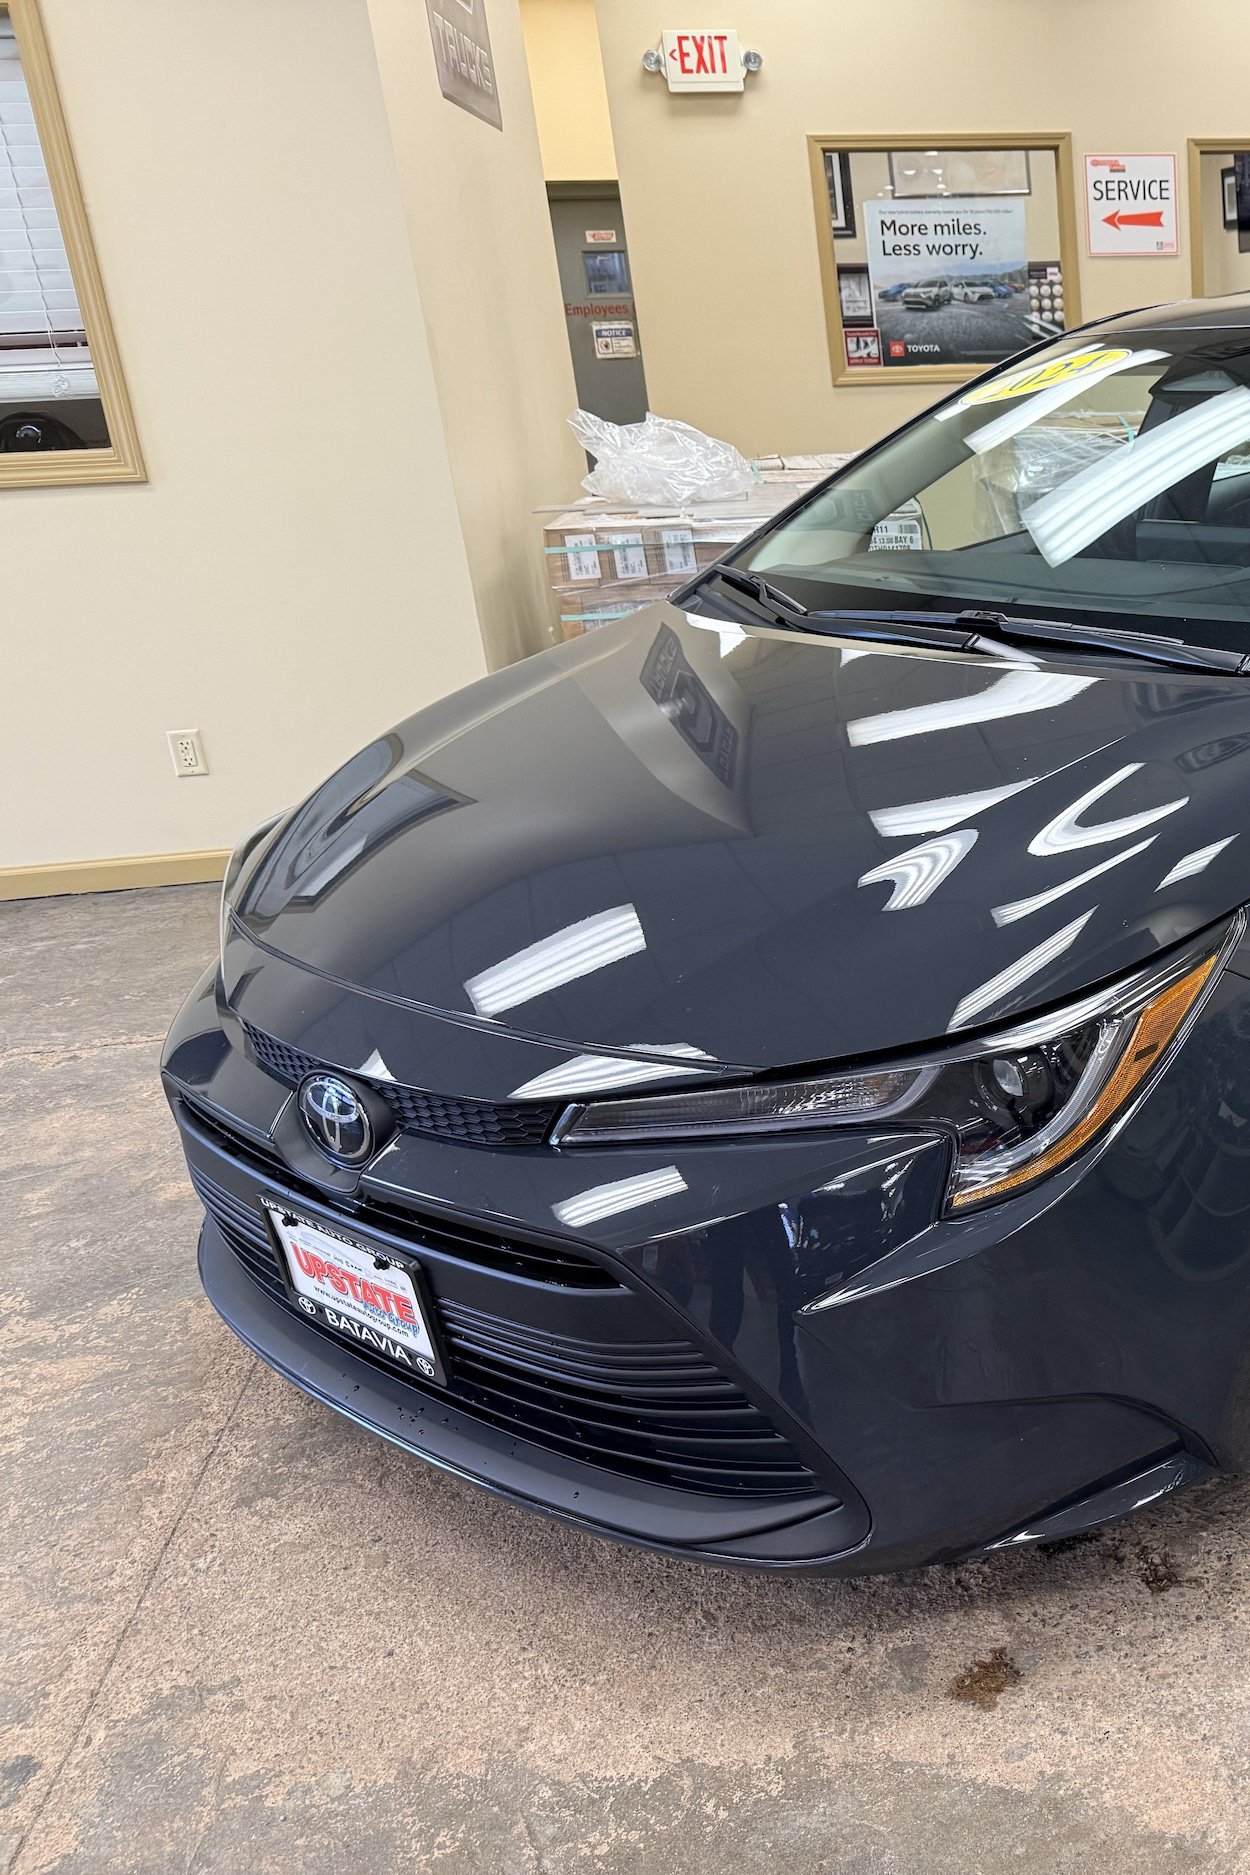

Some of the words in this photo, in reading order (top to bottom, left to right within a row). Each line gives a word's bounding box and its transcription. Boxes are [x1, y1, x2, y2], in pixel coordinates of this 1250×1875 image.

[677, 36, 728, 74] EXIT
[1093, 179, 1170, 201] SERVICE
[880, 219, 928, 236] More
[934, 218, 987, 236] miles.
[882, 240, 921, 256] Less
[926, 242, 983, 260] worry.
[564, 303, 628, 318] Employees
[602, 329, 626, 337] NOTICE
[907, 345, 940, 353] TOYOTA
[317, 1224, 353, 1246] AUTO
[356, 1243, 405, 1269] GROUP
[291, 1241, 418, 1325] UPSTATE
[388, 1311, 420, 1338] Group
[325, 1307, 412, 1366] BATAVIA
